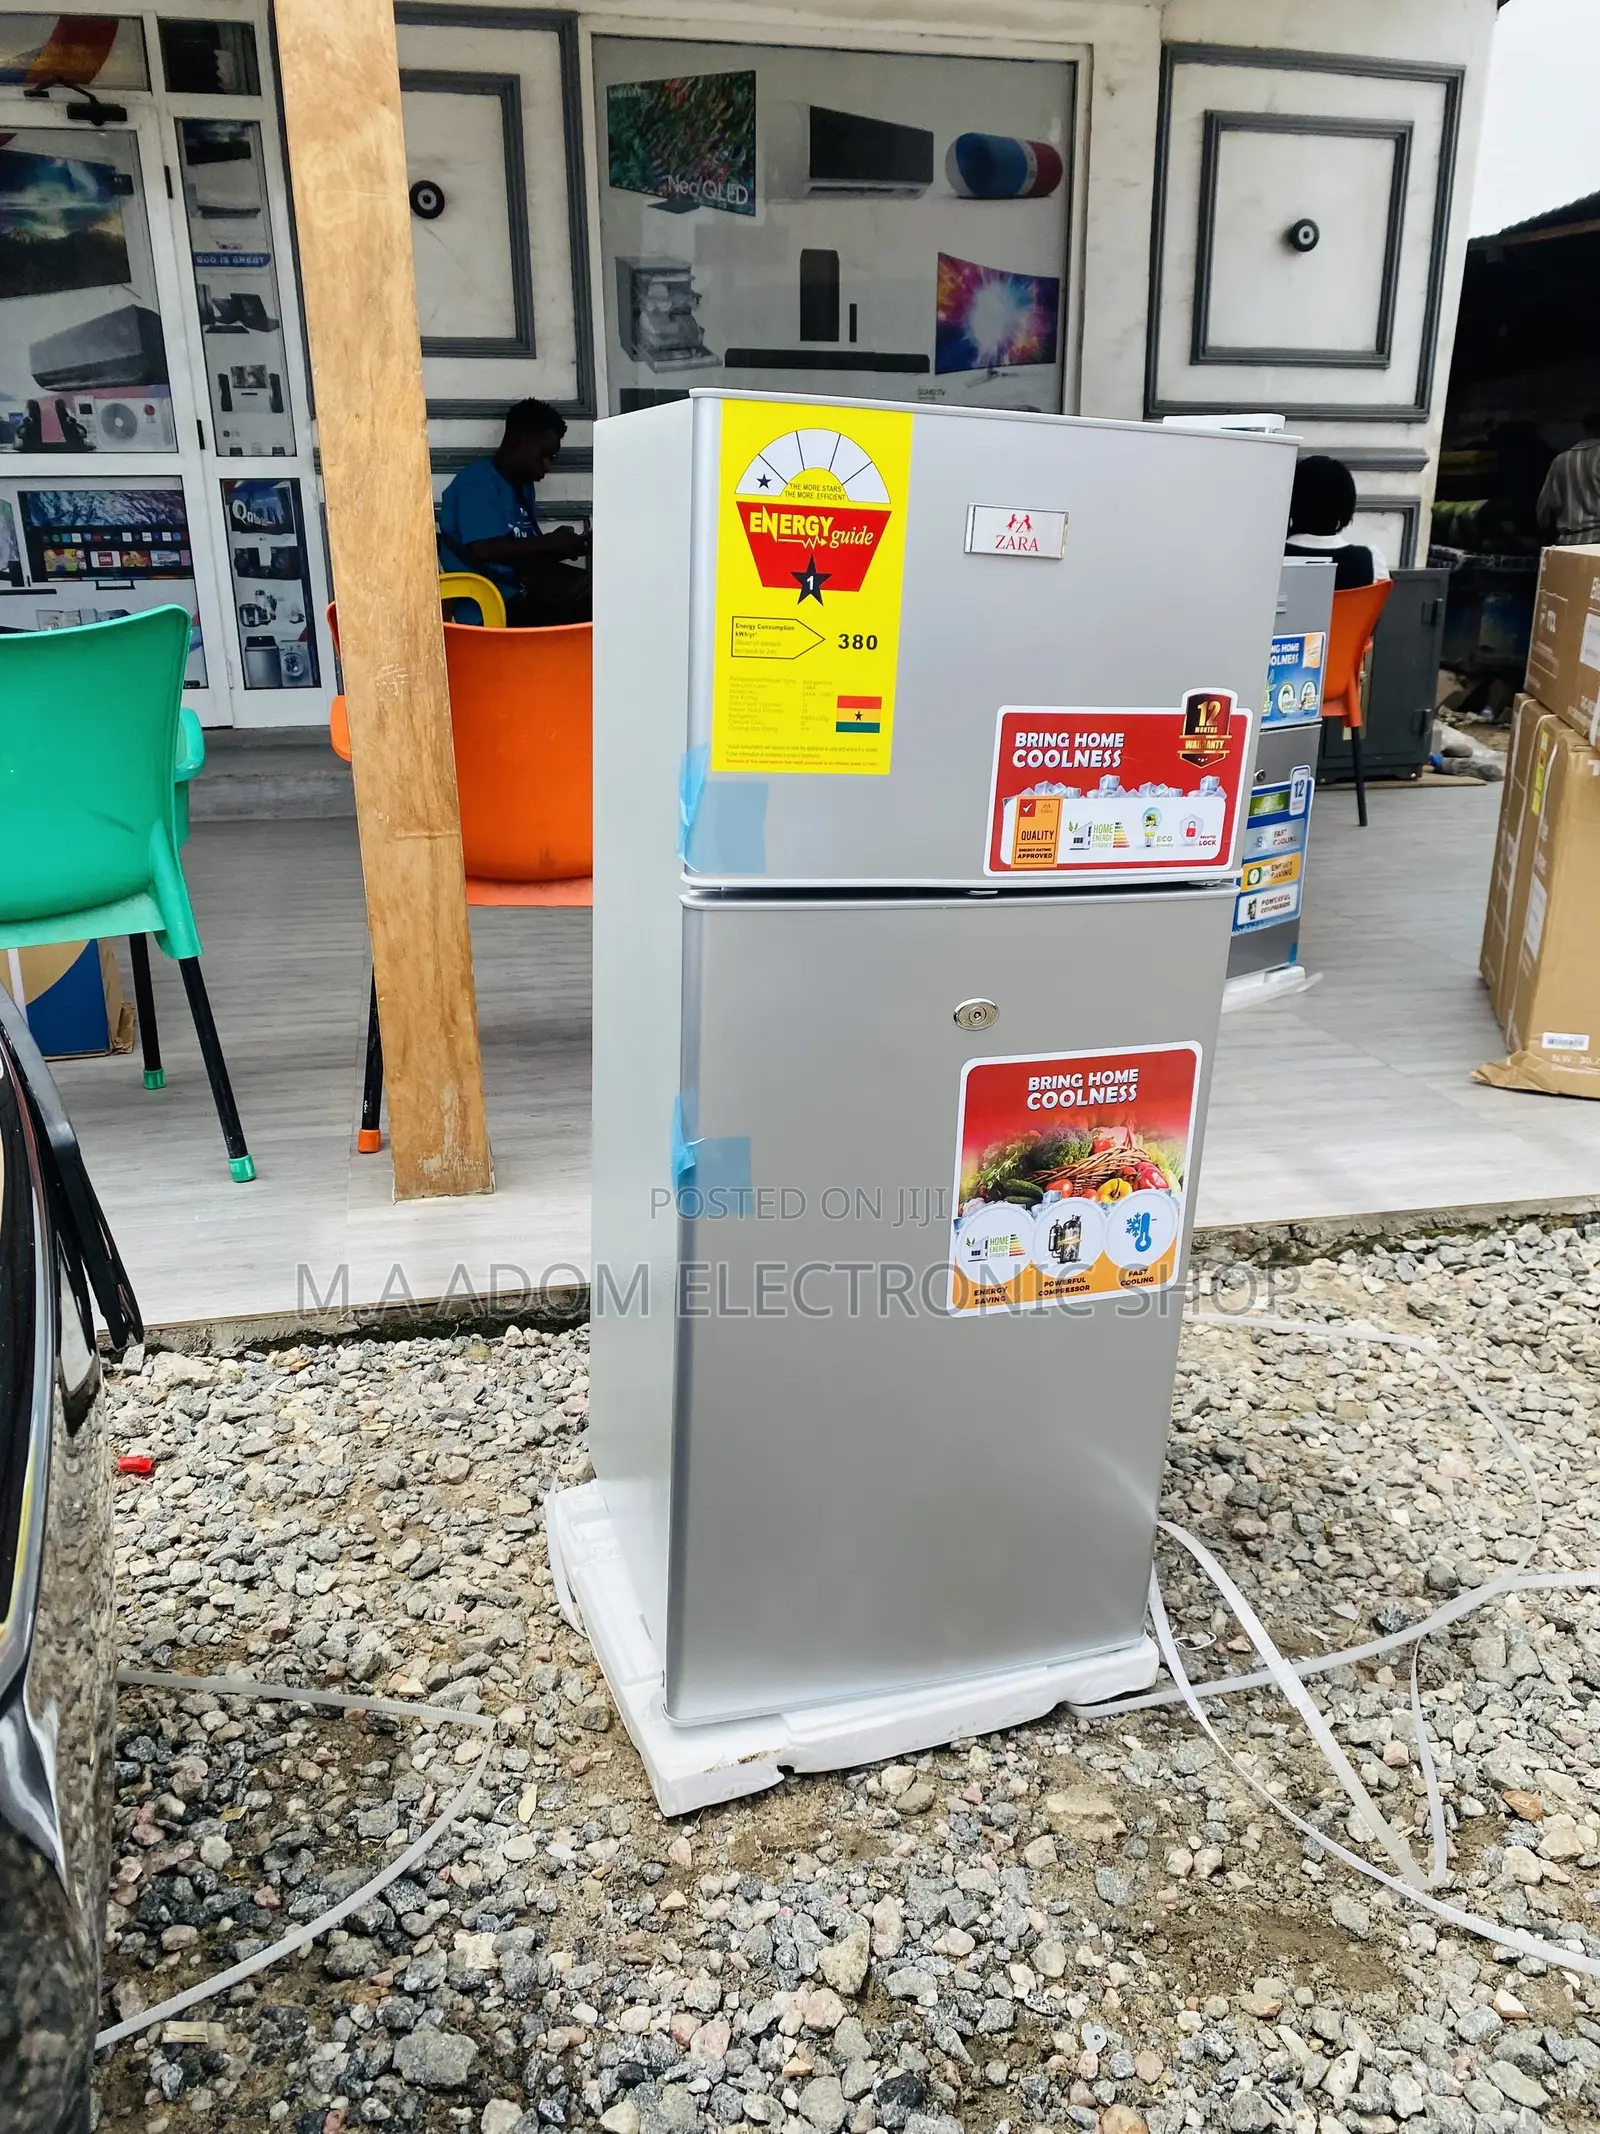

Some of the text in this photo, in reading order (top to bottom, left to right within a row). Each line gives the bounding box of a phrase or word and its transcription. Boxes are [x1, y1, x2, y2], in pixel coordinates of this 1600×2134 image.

[702, 180, 749, 205] QLED
[821, 485, 842, 493] STARS
[797, 491, 814, 499] MORE
[816, 493, 846, 501] EFFICIENT
[750, 505, 874, 549] ENERGY guide
[995, 534, 1039, 552] ZARA
[806, 576, 814, 591] 1
[735, 623, 795, 632] Energy Consumption
[838, 633, 878, 651] 380
[1197, 700, 1221, 727] 12
[1194, 726, 1218, 734] MONTHS
[1015, 732, 1125, 748] BRING HOME
[1185, 739, 1225, 750] WARRANTY
[1012, 749, 1122, 768] COOLNESS
[1294, 779, 1305, 798] 12
[1093, 823, 1114, 834] HOME
[1021, 830, 1055, 841] QUALITY
[1156, 835, 1173, 843] ECO
[1028, 1068, 1139, 1092] BRING HOME
[1026, 1084, 1138, 1110] COOLNESS
[989, 1235, 1010, 1246] HOME
[1128, 1268, 1149, 1277] FAST
[1044, 1276, 1087, 1288] POWERFUL
[1120, 1276, 1155, 1287] COOLING
[973, 1286, 1008, 1297] ENERGY
[1038, 1284, 1090, 1298] COMPRESSOR
[974, 1295, 1007, 1306] SAVING
